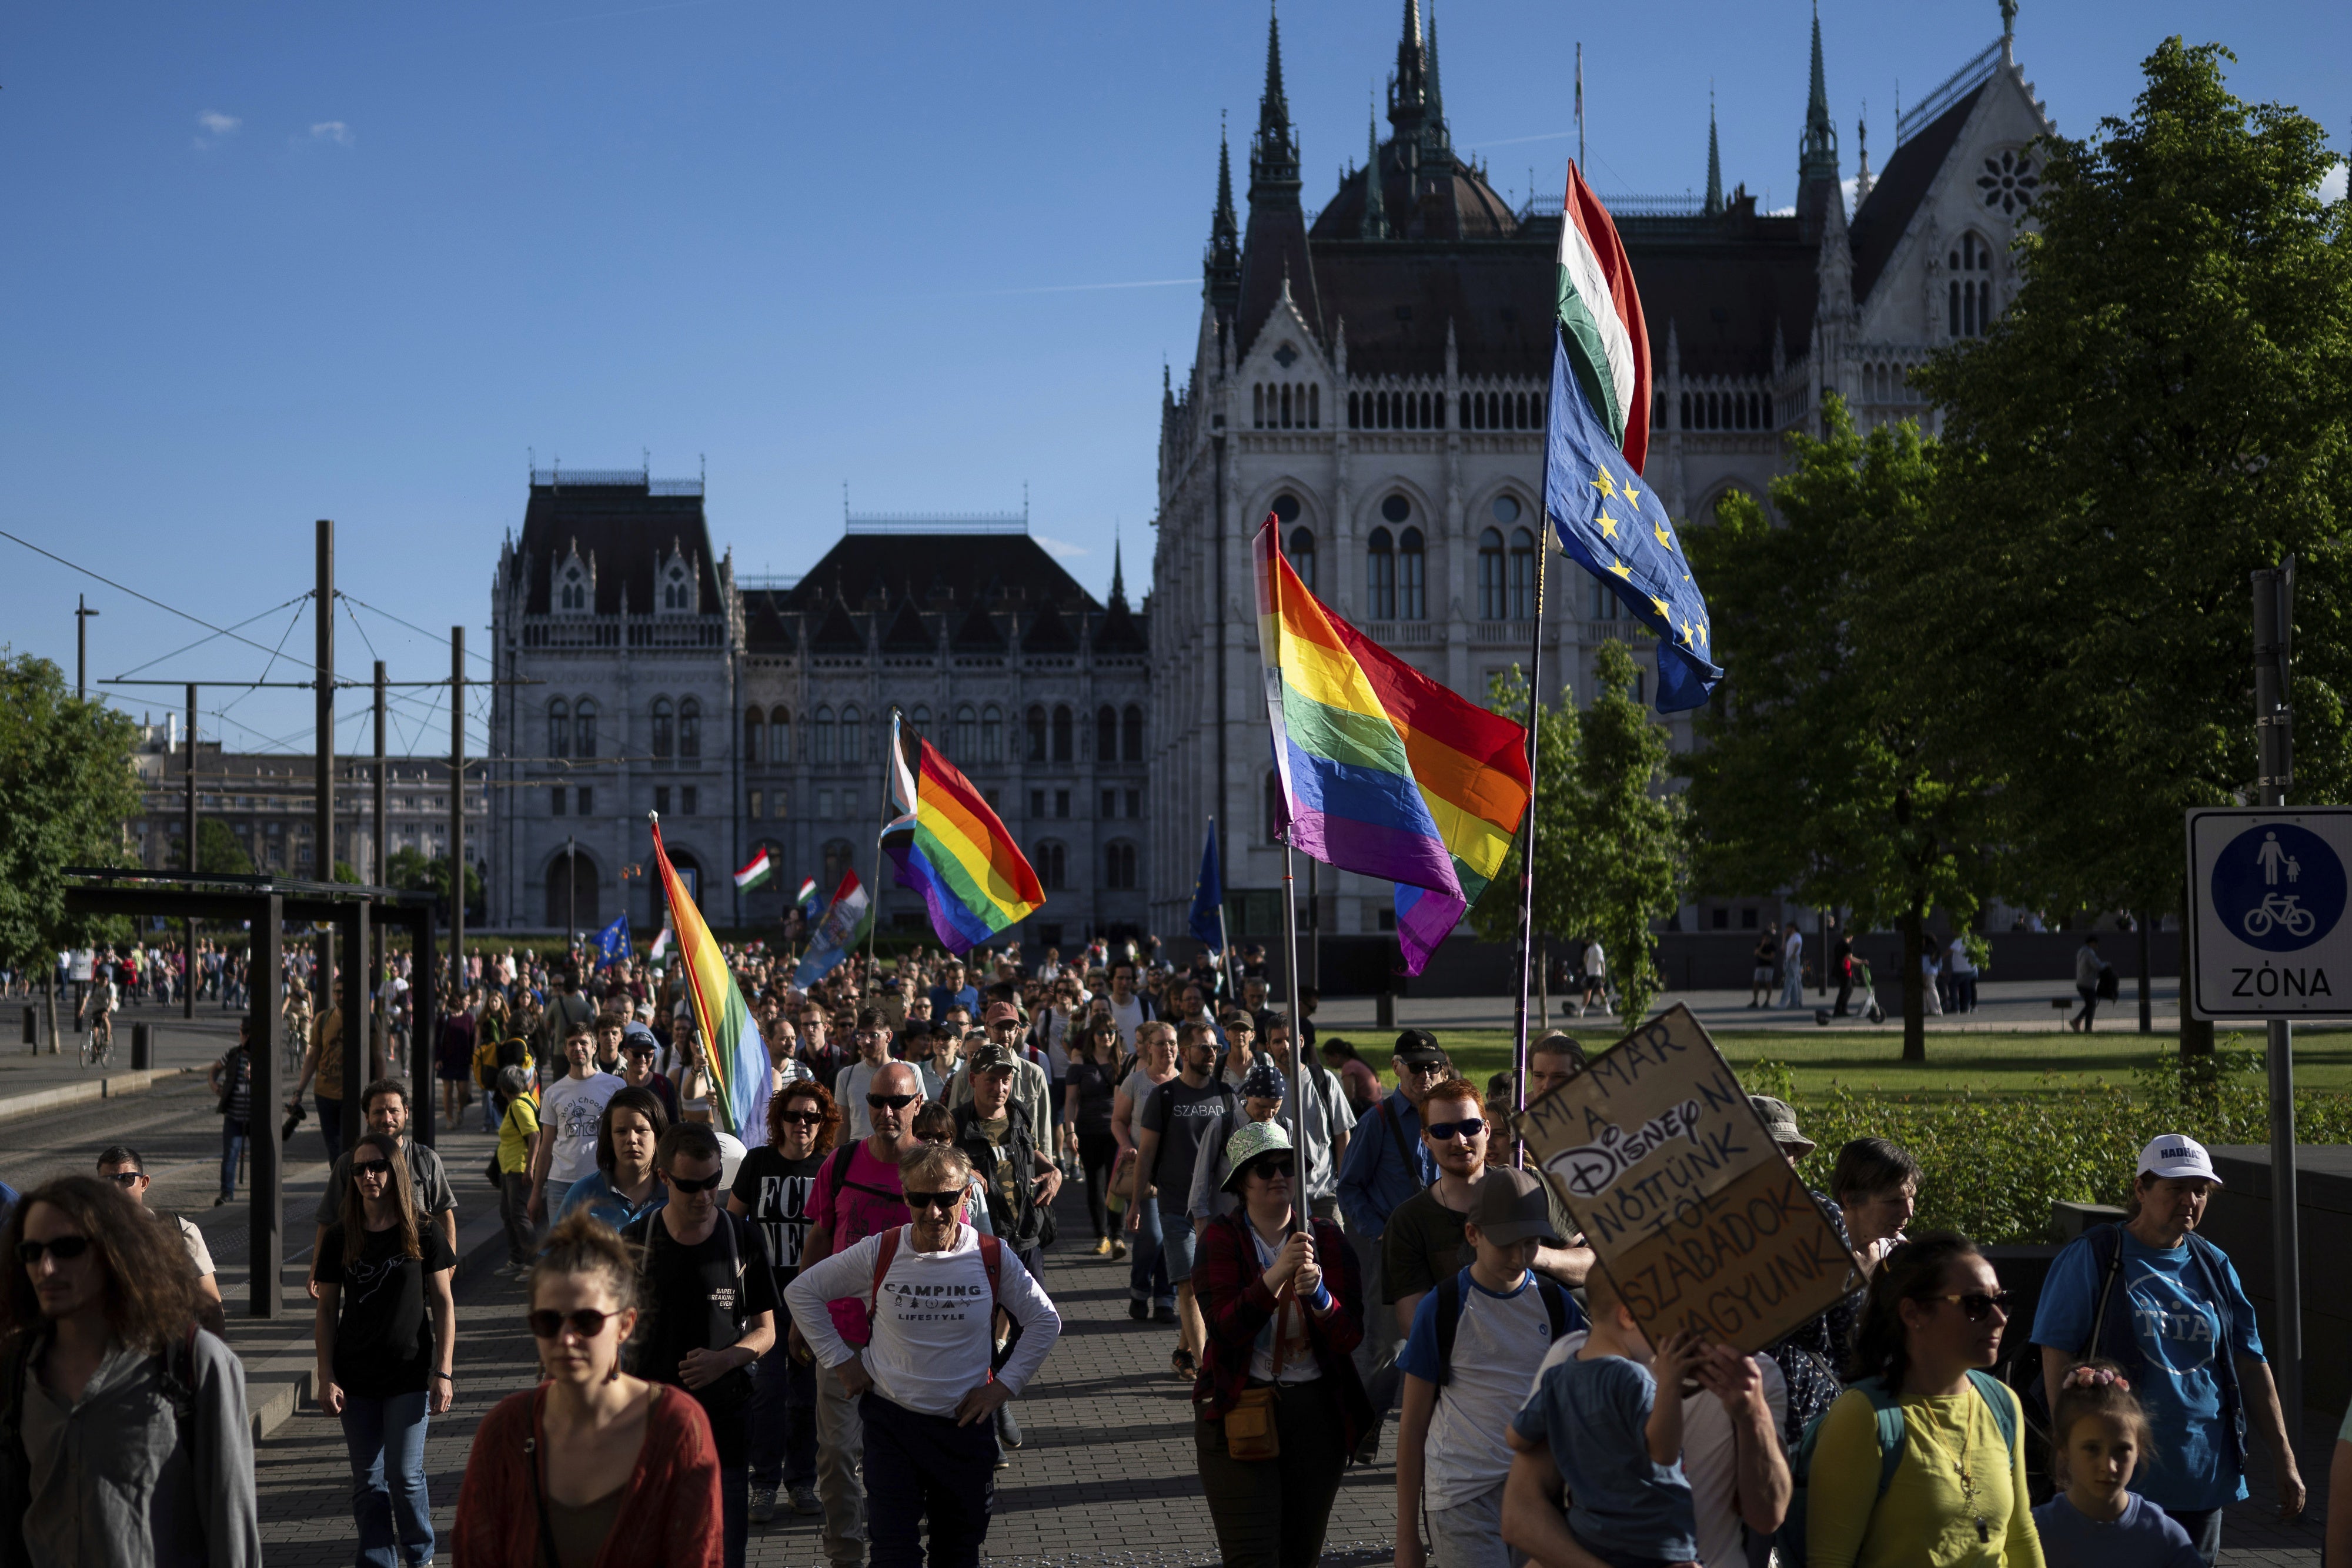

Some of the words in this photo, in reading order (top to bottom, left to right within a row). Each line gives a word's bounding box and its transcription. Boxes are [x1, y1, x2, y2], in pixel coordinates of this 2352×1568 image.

[2232, 960, 2331, 997] ZÓNA
[1174, 1105, 1224, 1116] SZABAD
[1529, 1092, 1574, 1139] MI
[1583, 1105, 1608, 1141] A
[1623, 1179, 1813, 1322] SZABADOK
[884, 1283, 981, 1296] CAMPING
[1656, 1225, 1846, 1341] AGYUNK
